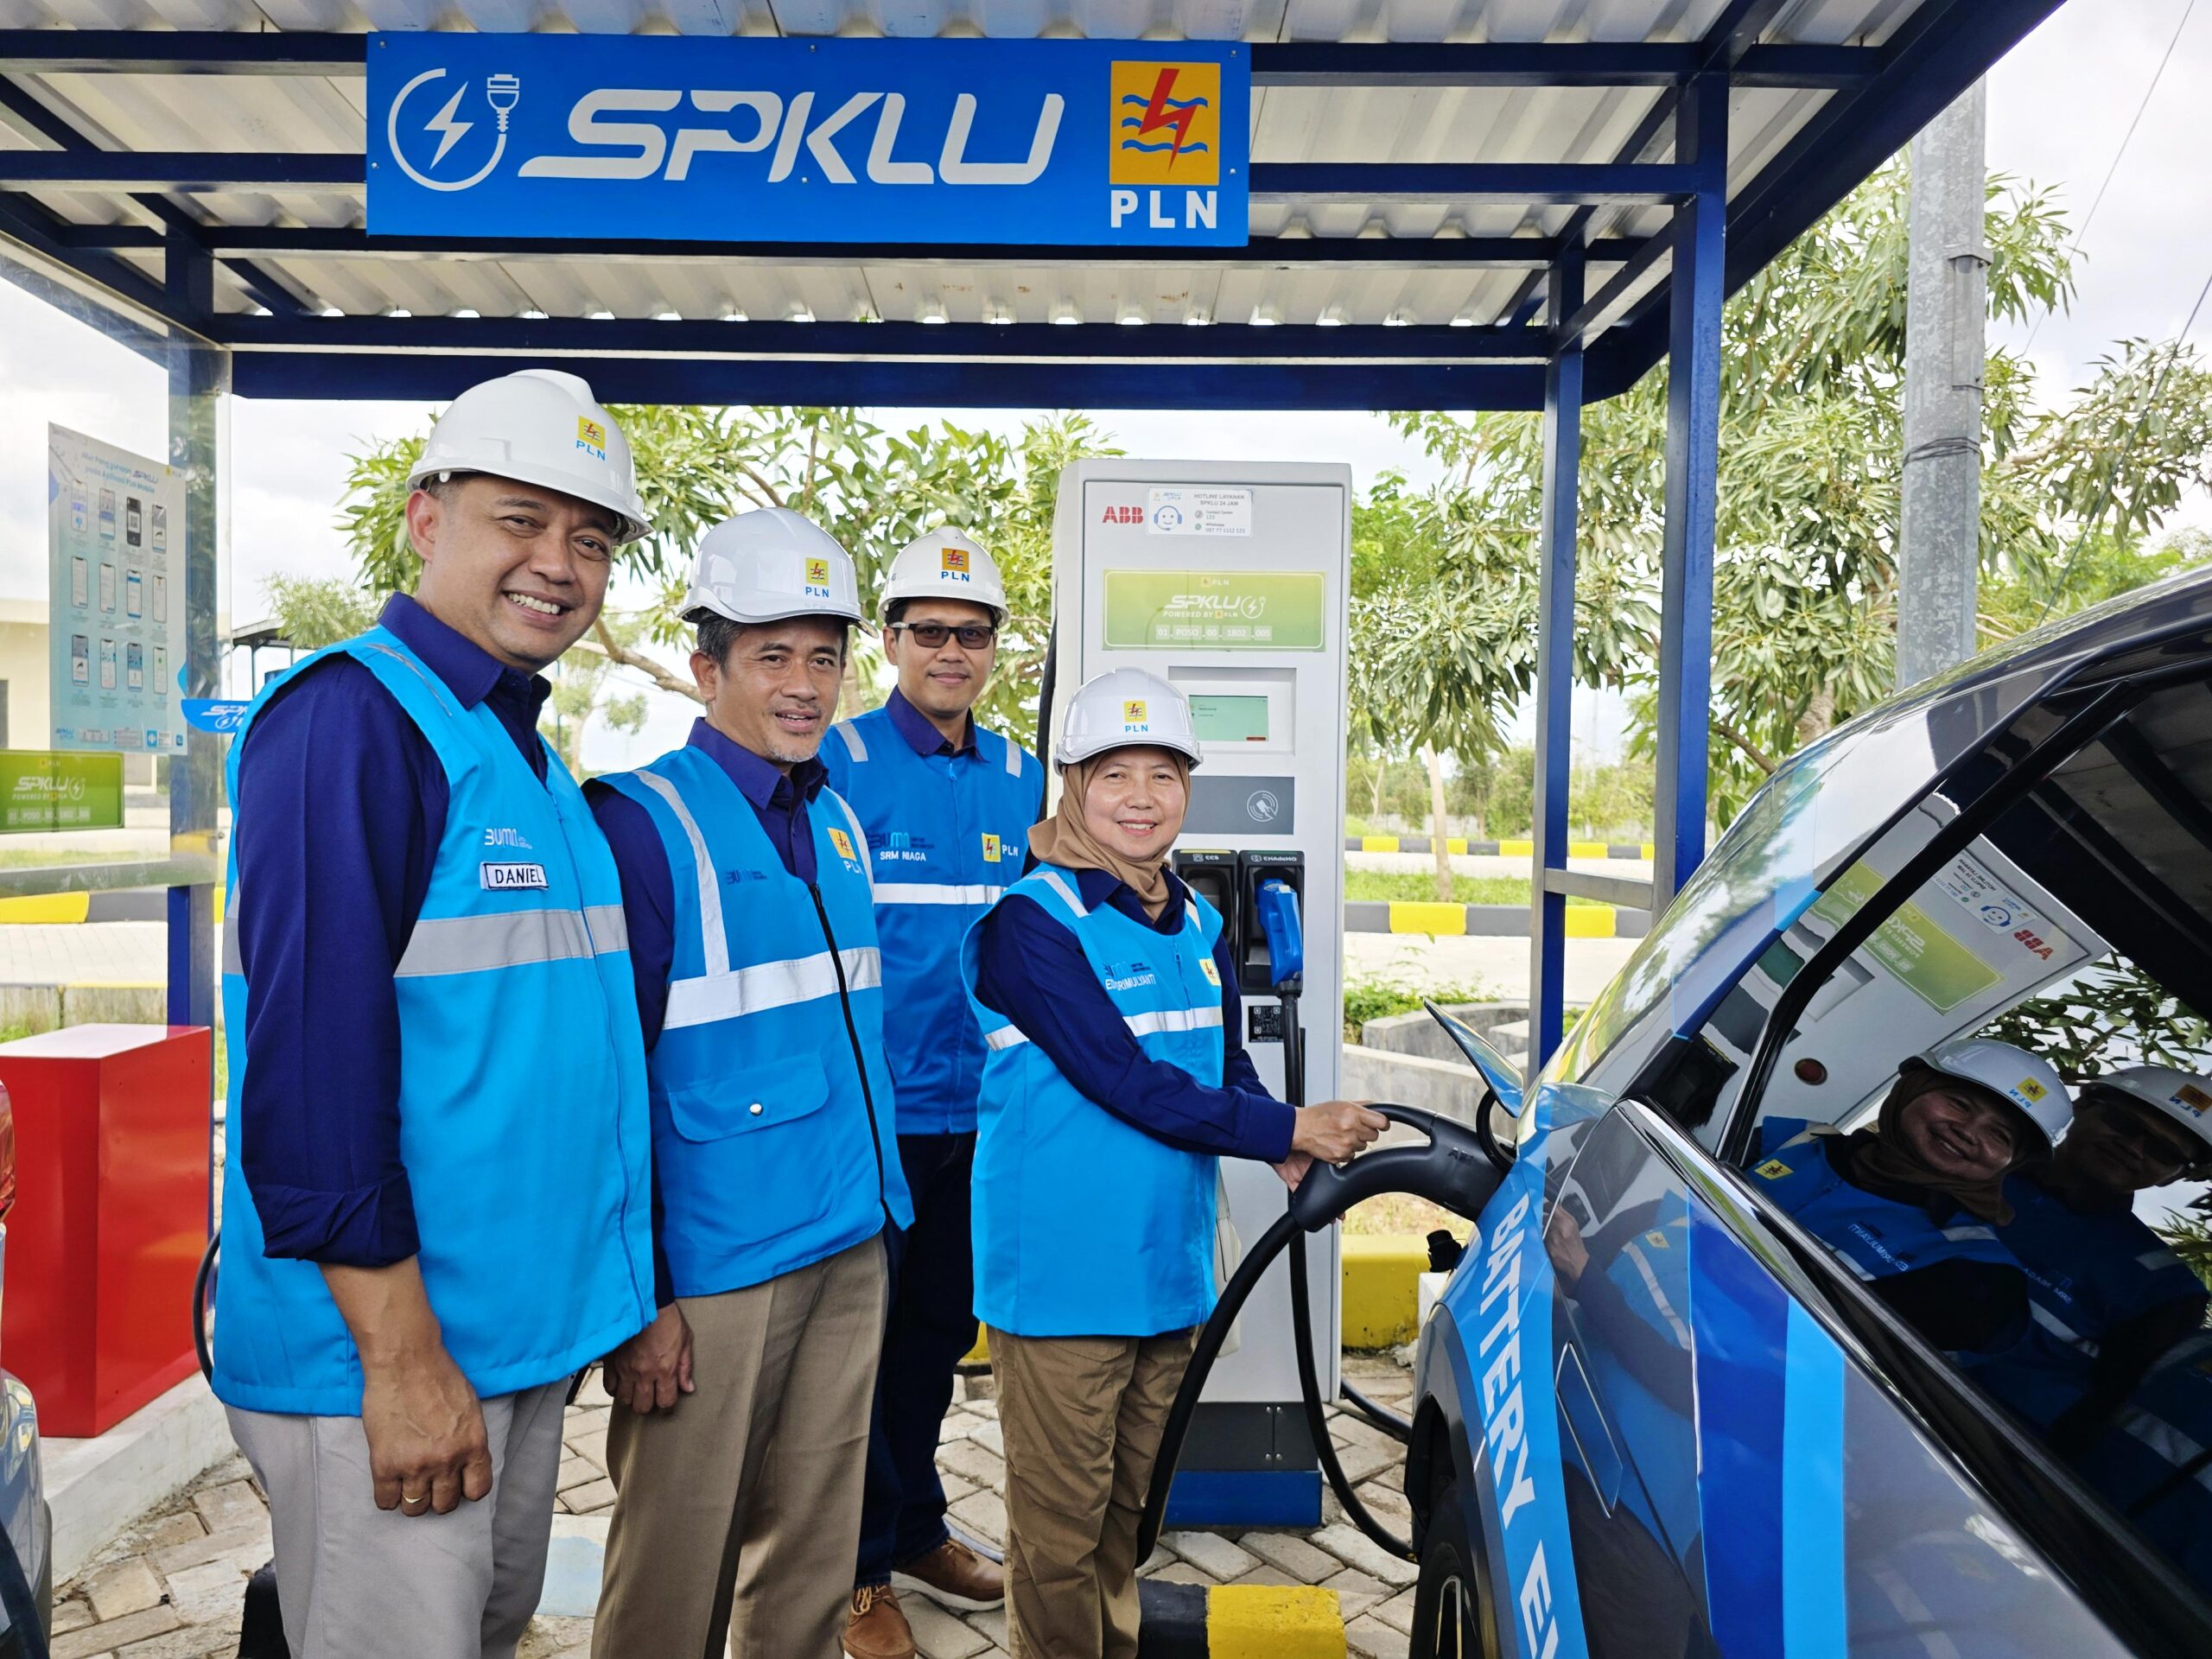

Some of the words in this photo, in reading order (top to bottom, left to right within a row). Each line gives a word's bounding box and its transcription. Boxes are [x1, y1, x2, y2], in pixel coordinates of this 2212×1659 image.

[518, 89, 1065, 185] SPKLU
[1110, 190, 1217, 229] PLN
[575, 440, 606, 461] PLN
[1103, 506, 1143, 524] ABB
[941, 571, 969, 582] PLN
[805, 587, 829, 598] PLN
[1164, 594, 1241, 609] SPKLU
[1125, 724, 1148, 733] PLN
[13, 776, 69, 791] SPKLU
[12, 792, 41, 801] POWERED
[880, 850, 899, 861] SRM
[902, 850, 926, 861] NIAGA
[1001, 844, 1019, 857] PLN
[495, 868, 543, 884] DANIEL
[1478, 1192, 1535, 1530] BATTERY
